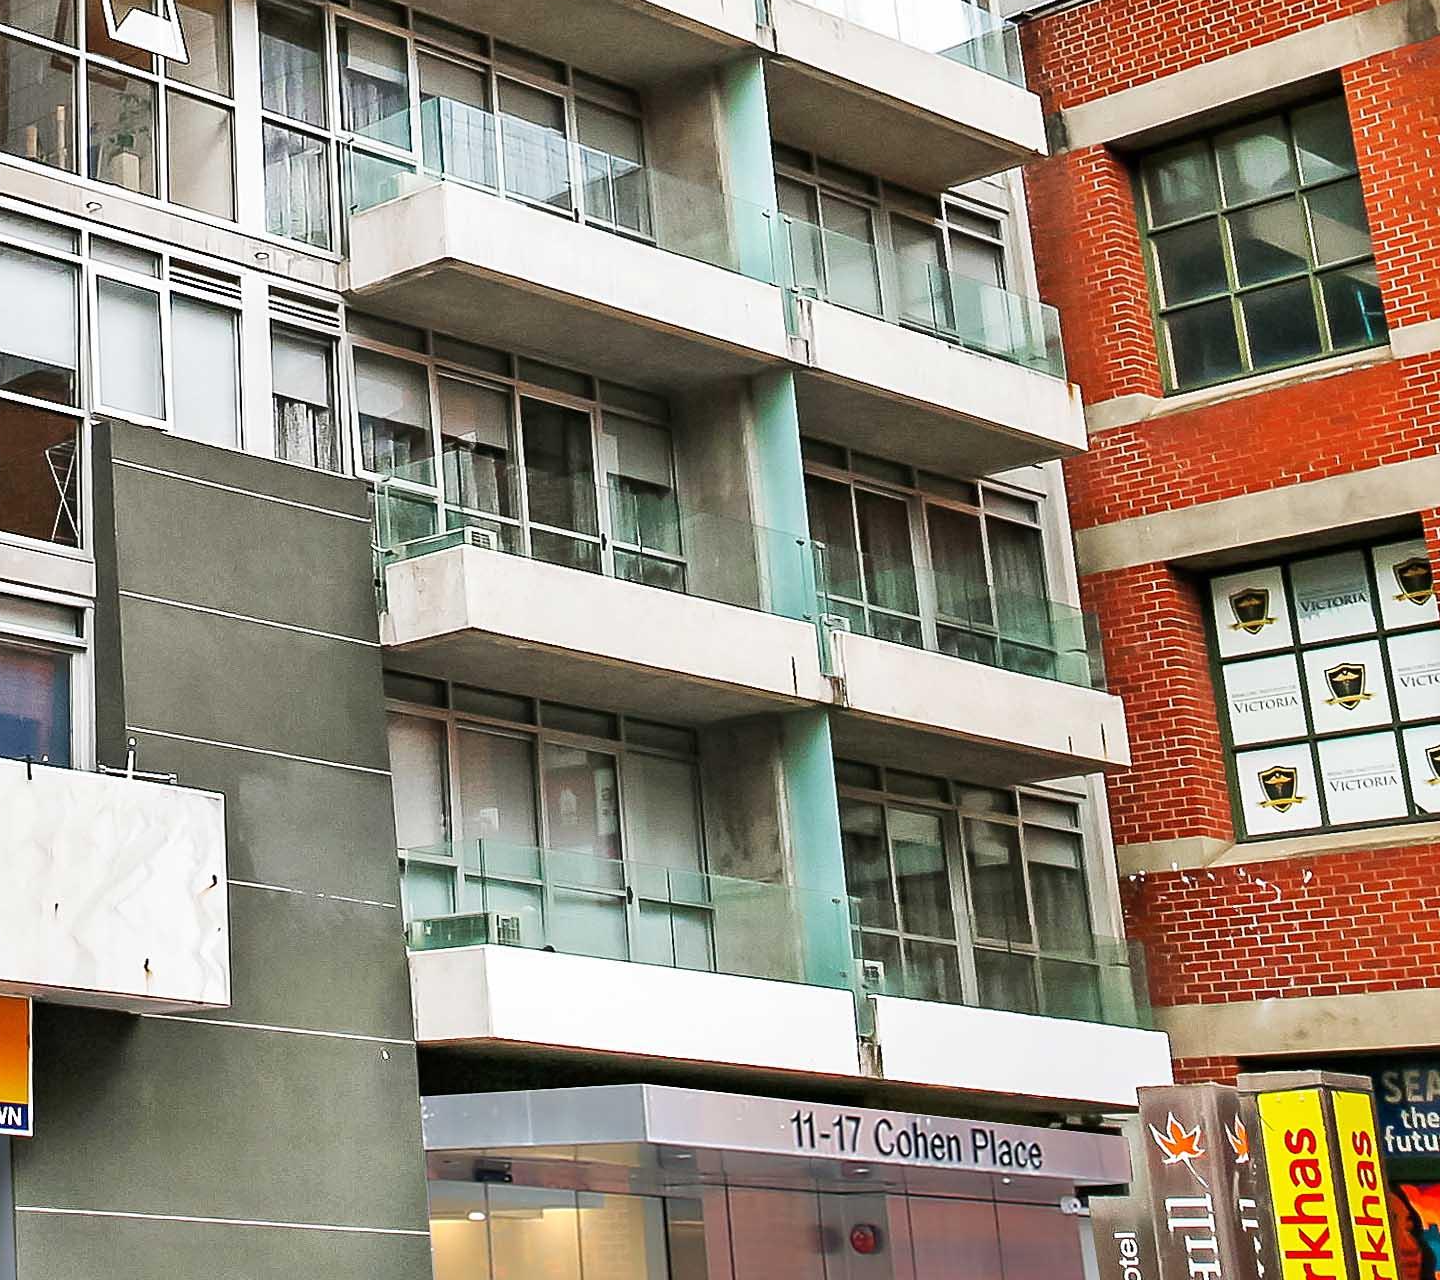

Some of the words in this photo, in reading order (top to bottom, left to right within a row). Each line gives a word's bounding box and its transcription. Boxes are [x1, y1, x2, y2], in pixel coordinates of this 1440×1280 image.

[789, 1109, 862, 1153] 11-17
[873, 1118, 962, 1163] Cohen
[970, 1128, 1043, 1170] Place
[1400, 1106, 1440, 1128] the
[1280, 1127, 1337, 1280] rkhas
